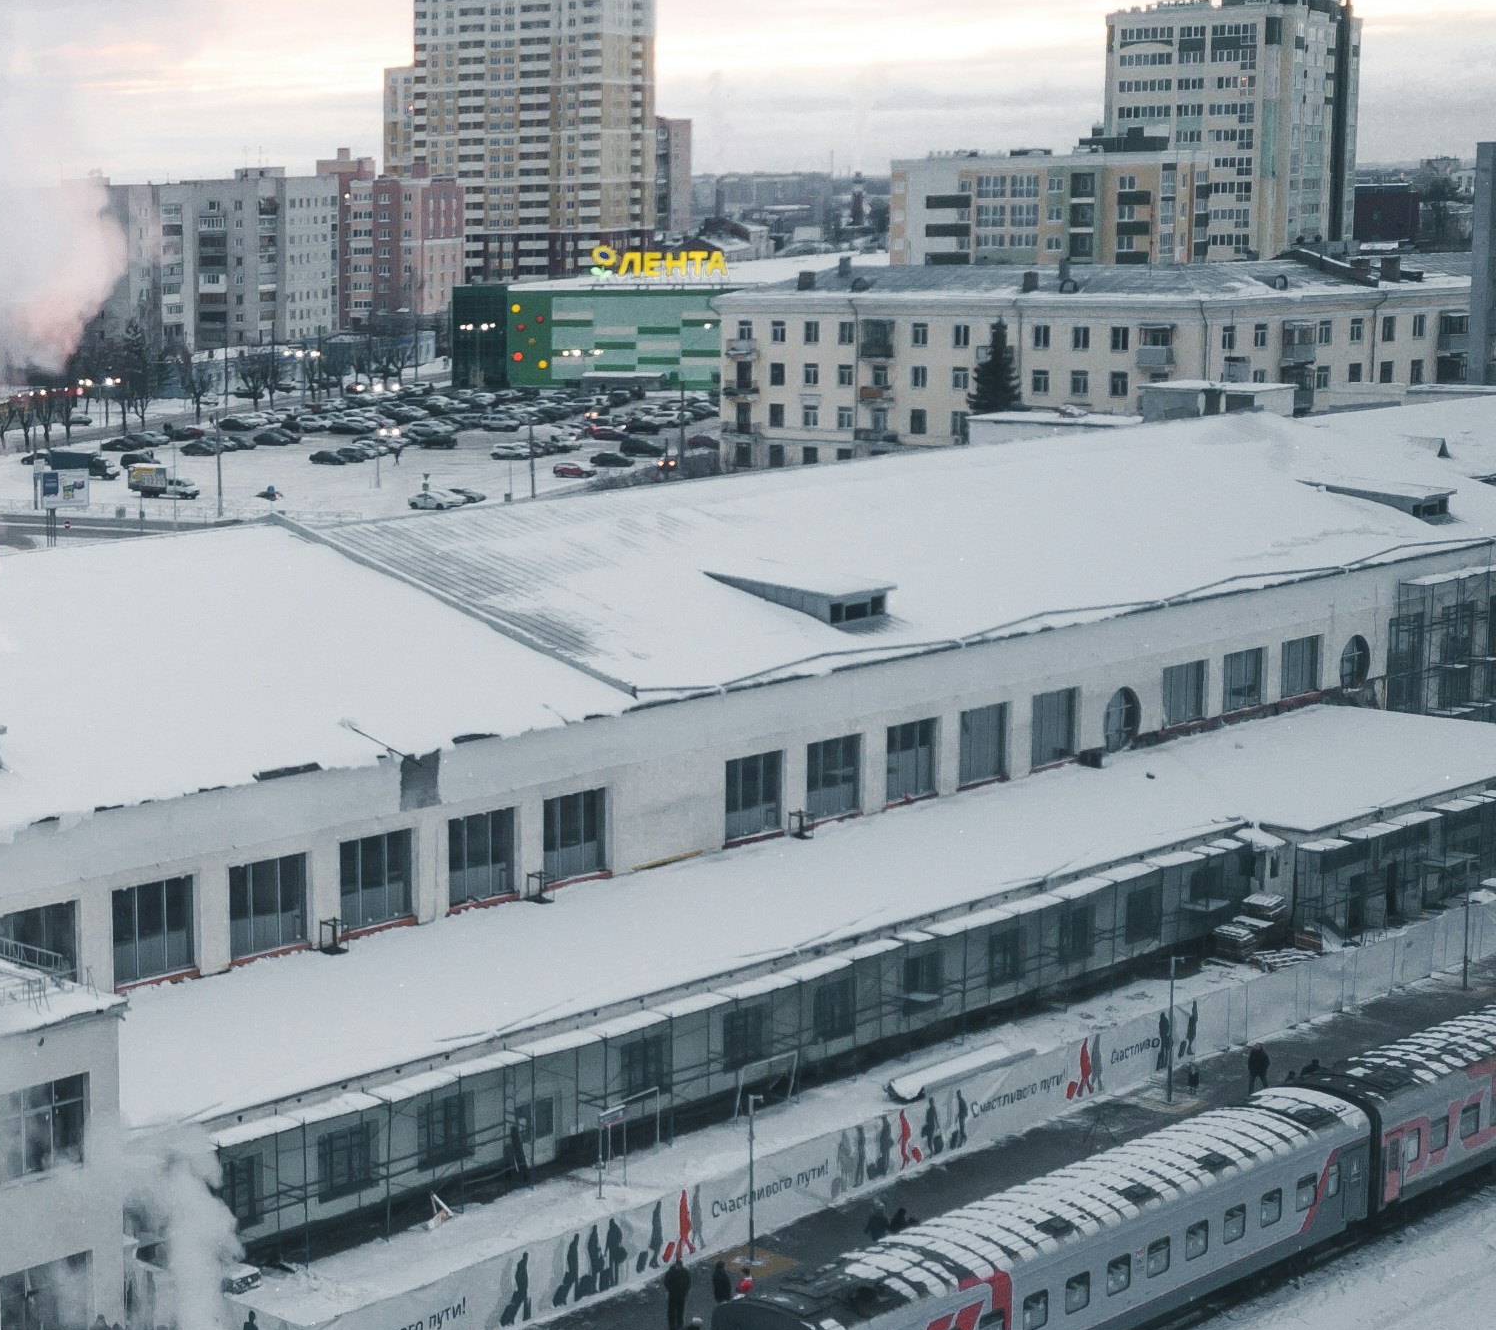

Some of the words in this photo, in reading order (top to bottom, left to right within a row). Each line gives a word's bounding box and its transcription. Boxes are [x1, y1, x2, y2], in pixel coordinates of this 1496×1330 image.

[617, 250, 729, 278] ЛЕНТА
[711, 1177, 792, 1218] Счастливого
[797, 1158, 829, 1188] пути!
[428, 1296, 466, 1330] пути!
